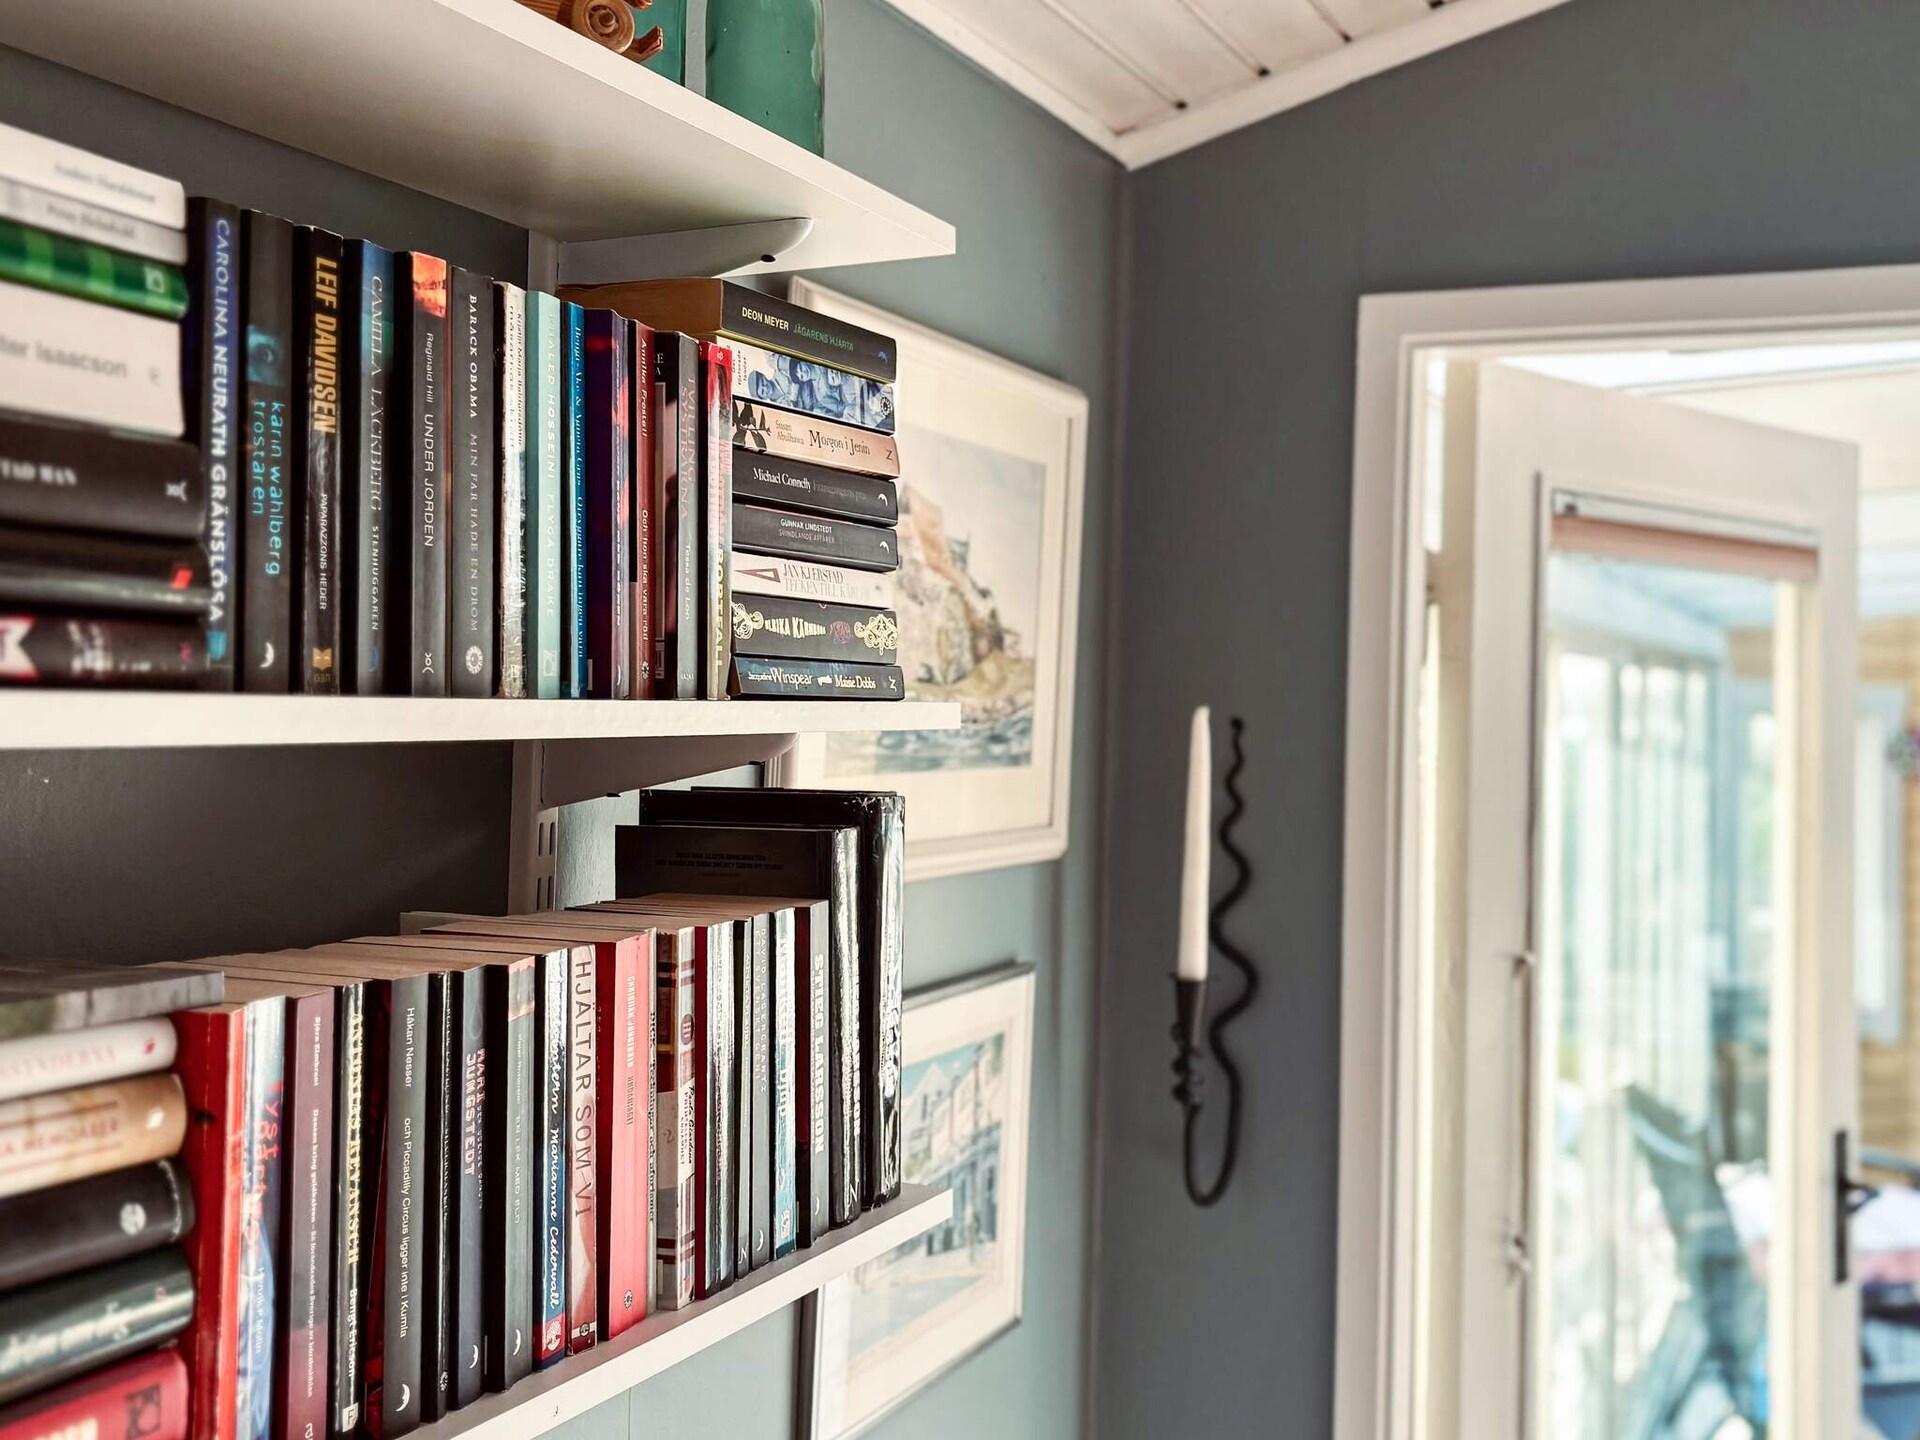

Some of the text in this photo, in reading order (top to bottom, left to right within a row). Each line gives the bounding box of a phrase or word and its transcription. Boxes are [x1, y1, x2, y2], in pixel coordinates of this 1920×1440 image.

[370, 275, 385, 377] CAMILLA
[468, 294, 479, 358] BARACK
[741, 307, 764, 324] DEON
[764, 315, 791, 332] MEYER
[312, 257, 338, 434] LEIF DAVIDSEN
[640, 338, 648, 384] Annika
[468, 362, 479, 419] OBAMA
[209, 219, 231, 623] CAROLINA NEURATH GRÄNSLÖSA
[423, 332, 435, 548] Reginald Hill UNDER JORDEN
[547, 394, 556, 479] HOSSEINI
[687, 376, 697, 483] TVILLING
[775, 419, 792, 432] Susan
[251, 401, 268, 516] trostaren
[469, 433, 480, 467] MIN
[809, 430, 845, 453] Morgon
[849, 438, 871, 456] Jenin
[264, 402, 286, 577] karin wahlberg
[469, 473, 479, 502] FAR
[753, 467, 782, 487] Michael
[781, 477, 812, 493] Connelly
[469, 508, 479, 552] HADE
[546, 493, 555, 549] FLYGA
[642, 509, 650, 534] Och
[780, 518, 833, 534] GUNNAR LINDSTEDT
[318, 494, 329, 611] PAPARAZZONS HEDER
[470, 558, 479, 580] EN
[371, 525, 381, 632] STENHUGGAREN
[546, 558, 555, 619] DRAKE
[642, 564, 650, 585] ska
[684, 578, 692, 594] de
[769, 667, 813, 691] Winspear
[856, 676, 877, 690] Dobbs
[312, 1016, 322, 1042] Björn
[405, 1007, 416, 1046] Håkan
[404, 1047, 414, 1088] Nesser
[814, 952, 825, 1156] STIEG LARSSON
[476, 1047, 487, 1104] MARI
[574, 960, 596, 1218] HJÄLTAR SOM VI
[311, 1109, 320, 1143] Dansen
[403, 1117, 412, 1139] och
[464, 1052, 477, 1176] JUNGSTEDT
[310, 1145, 319, 1171] kring
[401, 1142, 412, 1196] Piccadilly
[401, 1197, 411, 1235] Circus
[548, 1127, 561, 1310] Marianne Cederwall
[399, 1237, 411, 1269] ligger
[400, 1271, 410, 1293] inte
[348, 1287, 359, 1330] Bengt
[399, 1301, 409, 1339] Kumla
